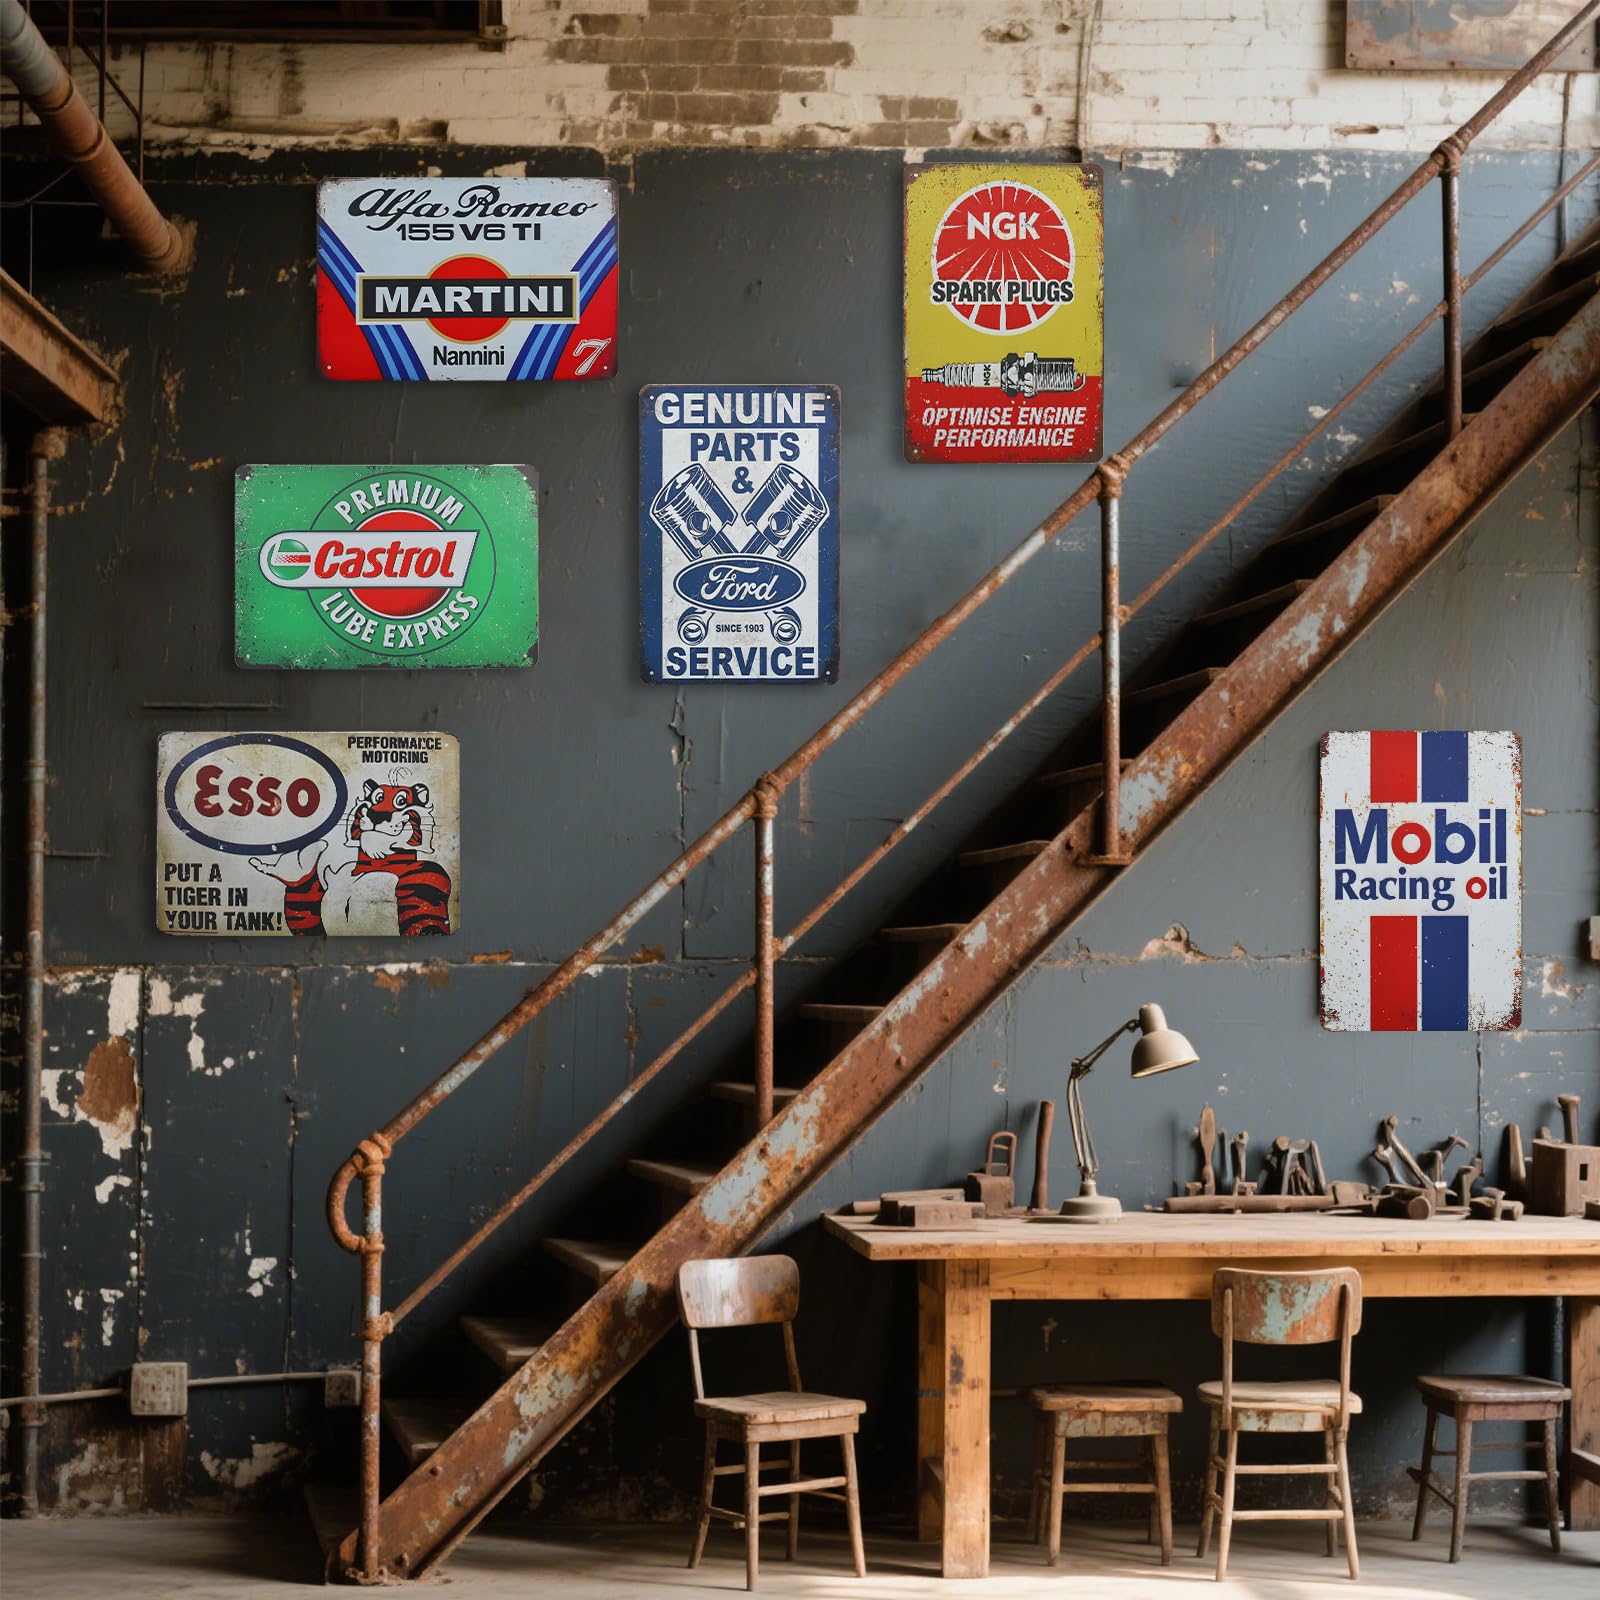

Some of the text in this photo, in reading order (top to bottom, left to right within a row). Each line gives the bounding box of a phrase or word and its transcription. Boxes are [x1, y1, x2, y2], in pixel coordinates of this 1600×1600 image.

[348, 185, 598, 231] Alfa Romeo
[396, 223, 541, 241] 155 V6 TI
[967, 211, 1040, 240] NGK
[375, 285, 564, 313] MARTINI
[932, 281, 1074, 303] SPARK PLUGS
[433, 345, 505, 366] Nannini
[573, 338, 611, 376] 7
[654, 392, 826, 425] GENUINE
[922, 407, 1087, 426] OPTIMISE ENGINE
[690, 432, 800, 462] PARTS
[933, 428, 1075, 448] PERFORMANCE
[732, 466, 754, 494] &
[334, 479, 465, 524] PREMIUM
[314, 540, 457, 579] Castrol
[700, 564, 777, 601] Ford
[320, 590, 479, 649] LUBE EXPRESS
[715, 624, 764, 633] SINCE 1903
[666, 646, 815, 677] SERVICE
[347, 736, 442, 750] PERFORMANCE
[362, 750, 428, 763] MOTORING
[1334, 808, 1507, 864] Mobil
[164, 863, 222, 882] PUT A
[164, 887, 248, 906] TIGER IN
[1334, 866, 1508, 911] Racing oil
[164, 911, 283, 931] YOUR TANK!
